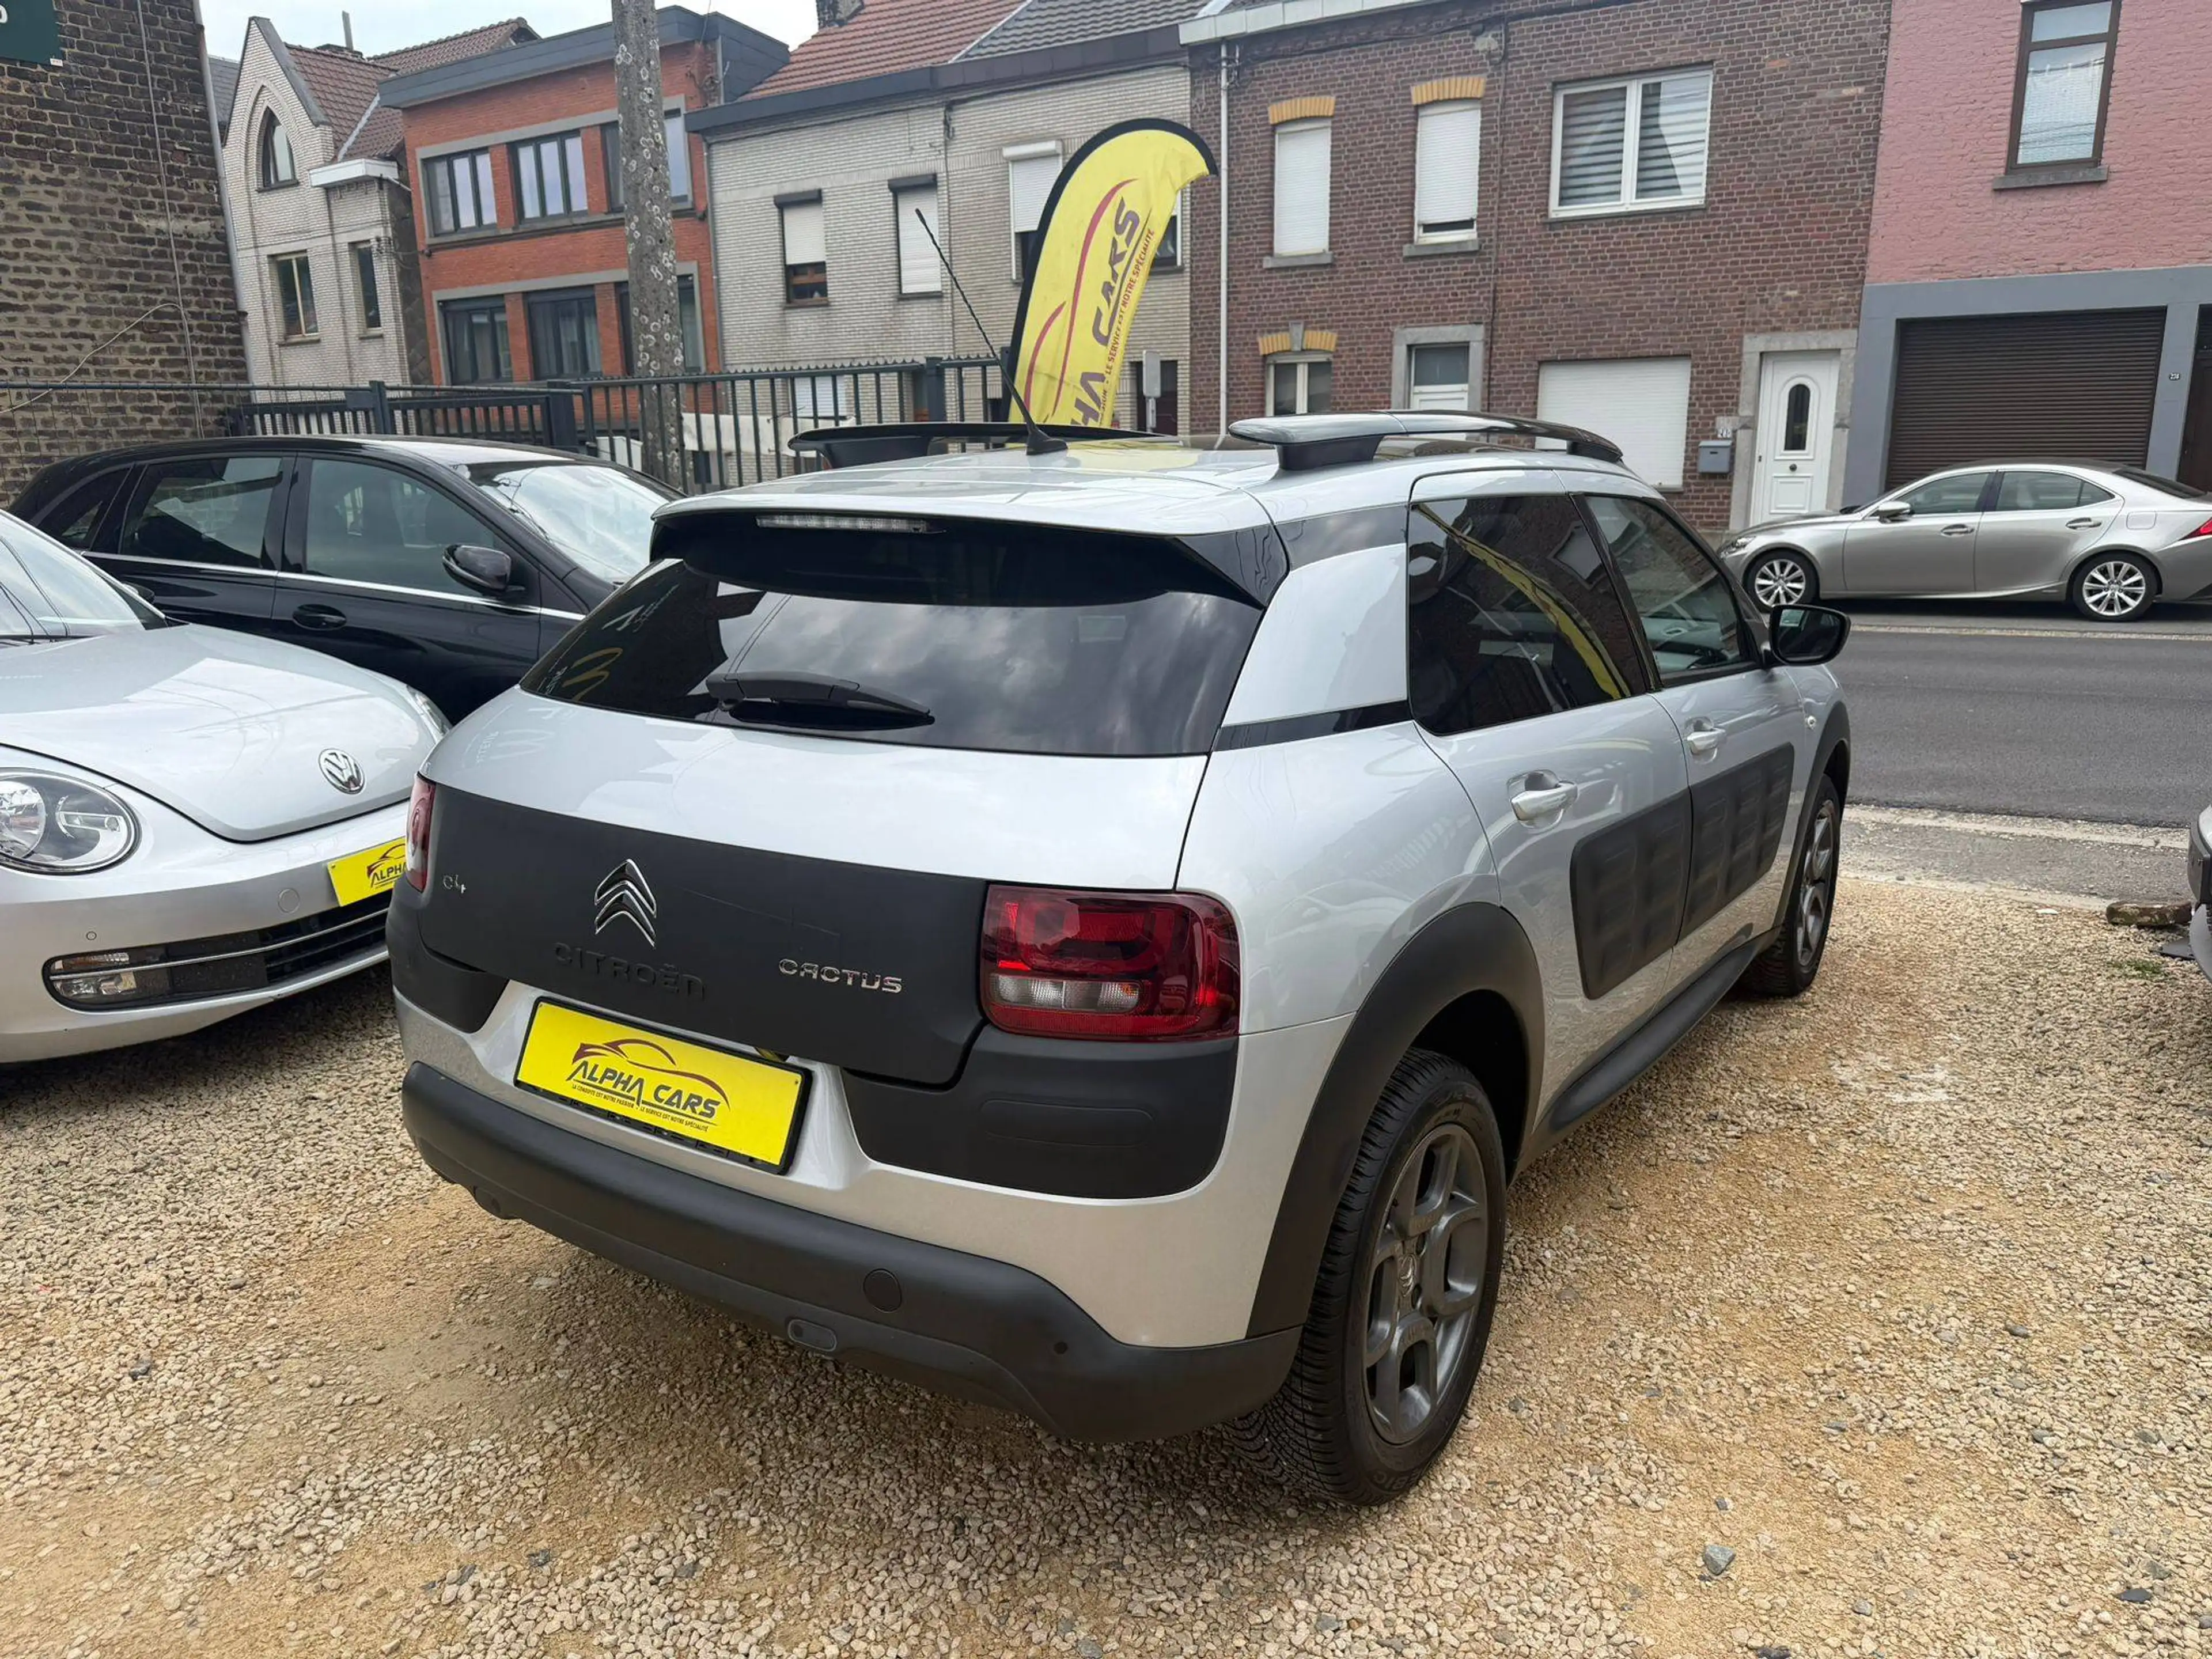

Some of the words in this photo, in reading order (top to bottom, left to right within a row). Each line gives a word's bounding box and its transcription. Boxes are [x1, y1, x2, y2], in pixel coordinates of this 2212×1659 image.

[1070, 372, 1107, 425] HA
[1092, 195, 1140, 348] CARS
[1105, 364, 1113, 375] LE
[1120, 278, 1137, 308] NOTRE
[442, 874, 467, 894] C4
[555, 942, 706, 1001] CITROËN
[778, 958, 903, 994] CACTUS
[566, 1060, 645, 1107] ALPHA
[653, 1084, 721, 1119] CARS
